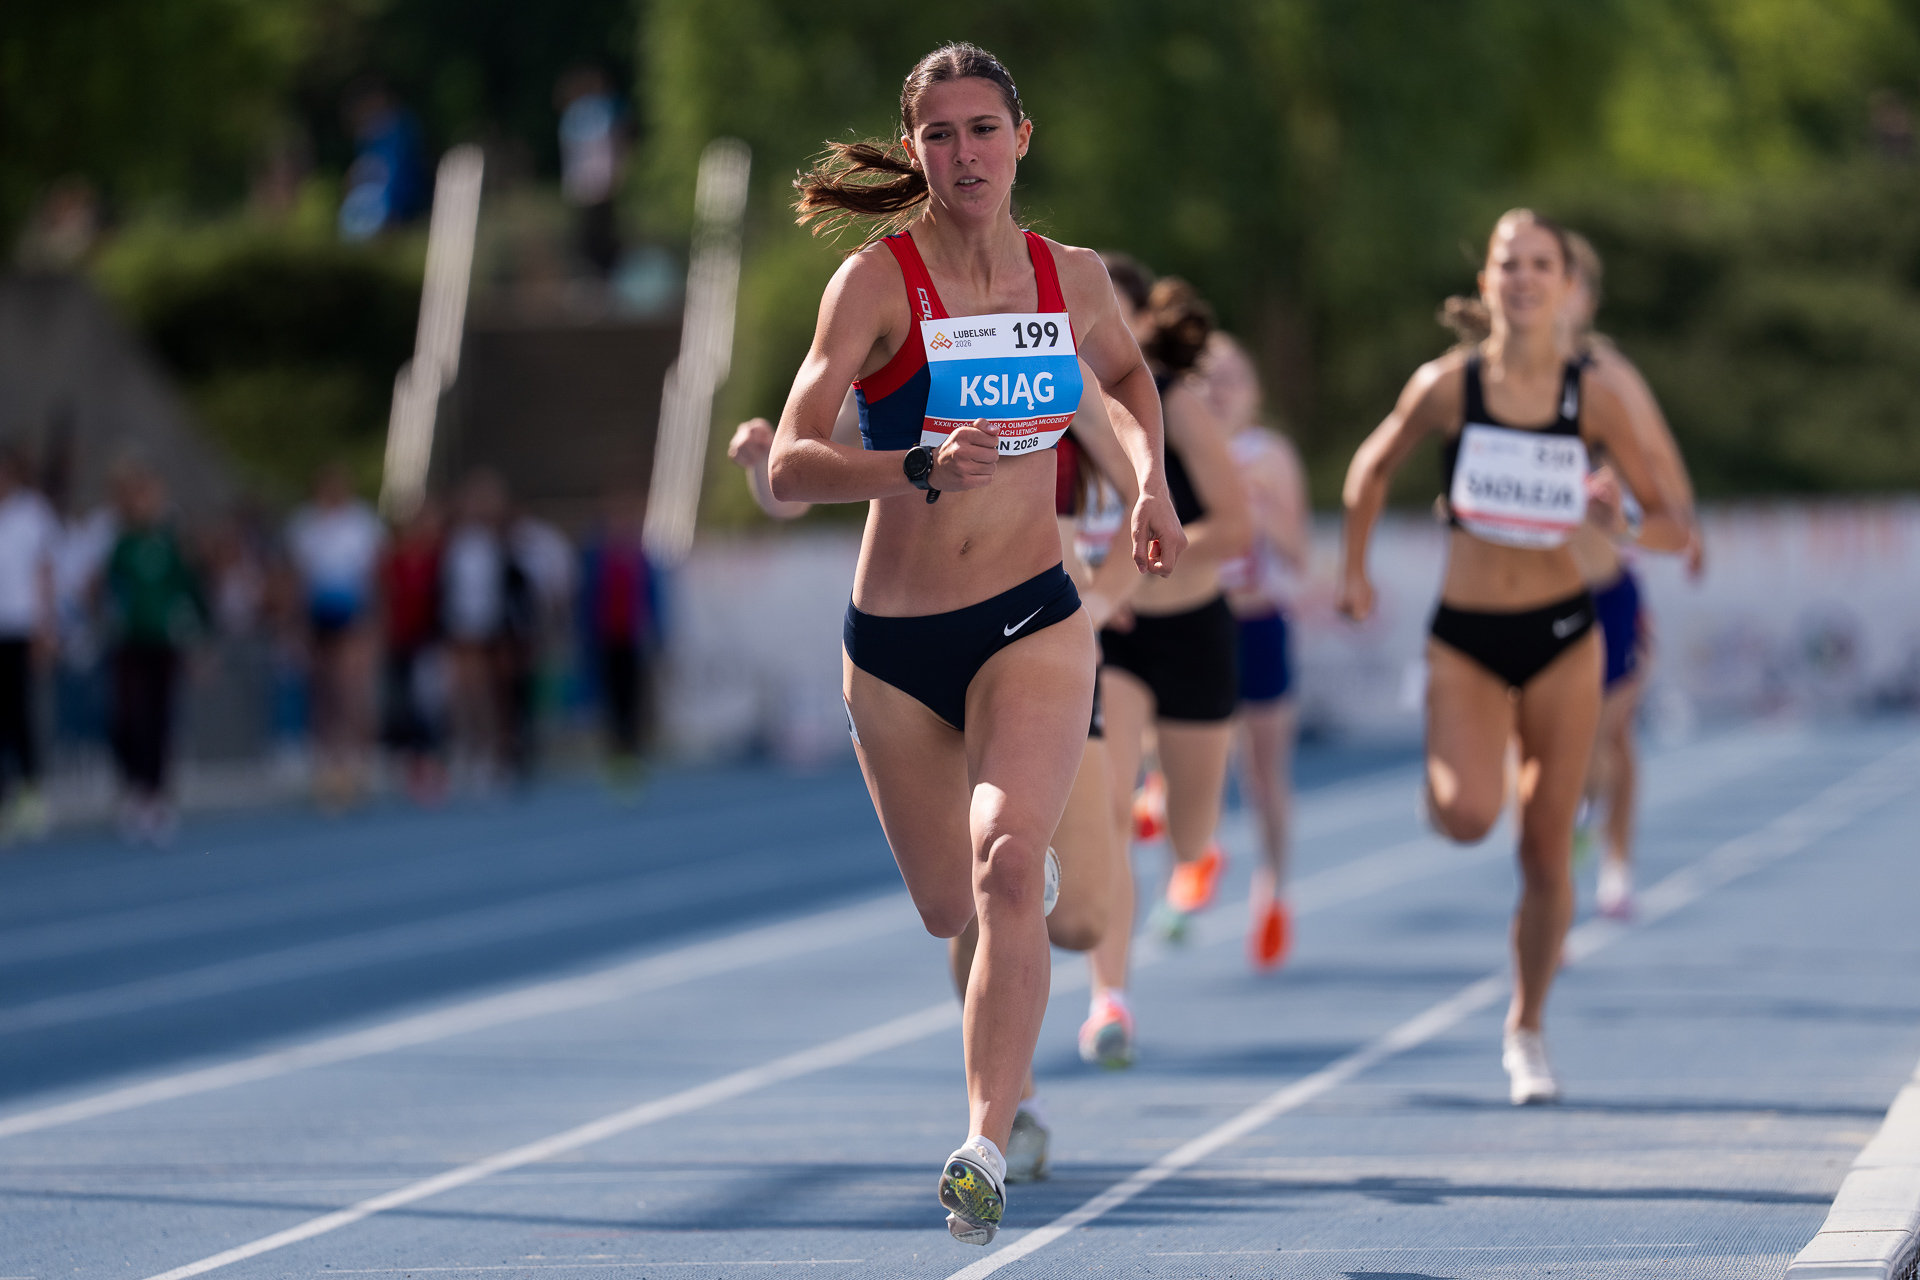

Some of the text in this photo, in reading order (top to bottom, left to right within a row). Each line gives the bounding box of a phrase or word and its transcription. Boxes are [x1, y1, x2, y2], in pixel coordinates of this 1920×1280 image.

[953, 328, 997, 339] LUBELSKIE
[1012, 321, 1059, 349] 199
[955, 340, 972, 348] 2026
[960, 371, 1055, 411] KSIĄG
[1008, 420, 1038, 429] OLIMPIADA
[1039, 416, 1069, 425] MŁODZIEŻY
[1016, 427, 1038, 435] LETNICH
[1013, 436, 1039, 451] 2026
